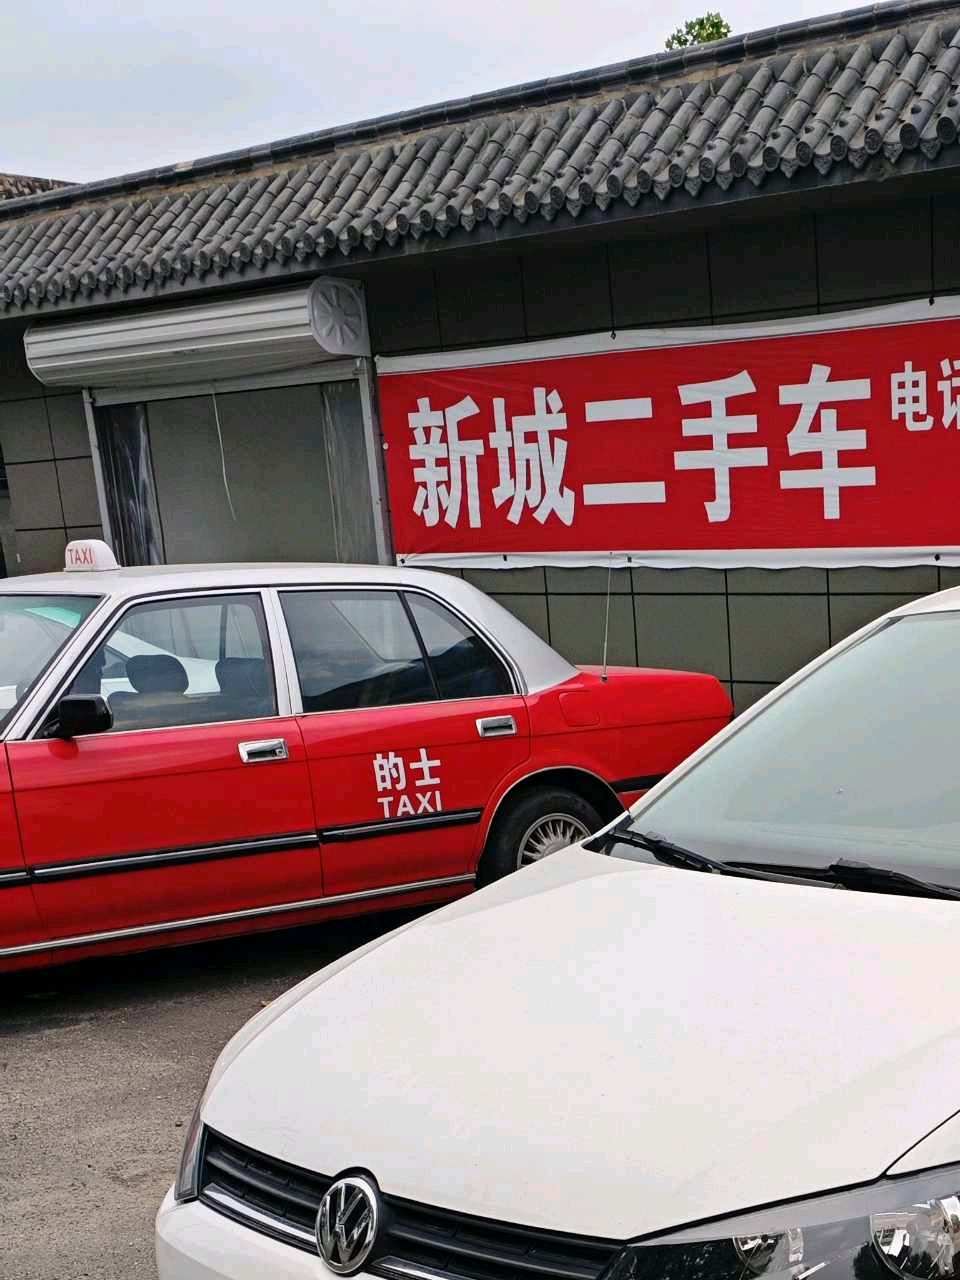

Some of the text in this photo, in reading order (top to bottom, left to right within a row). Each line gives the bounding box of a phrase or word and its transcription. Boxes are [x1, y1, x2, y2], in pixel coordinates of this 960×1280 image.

[407, 363, 877, 529] 新城二手车
[67, 547, 94, 565] TAXI
[372, 747, 442, 792] 的士
[376, 790, 442, 818] TAXI
